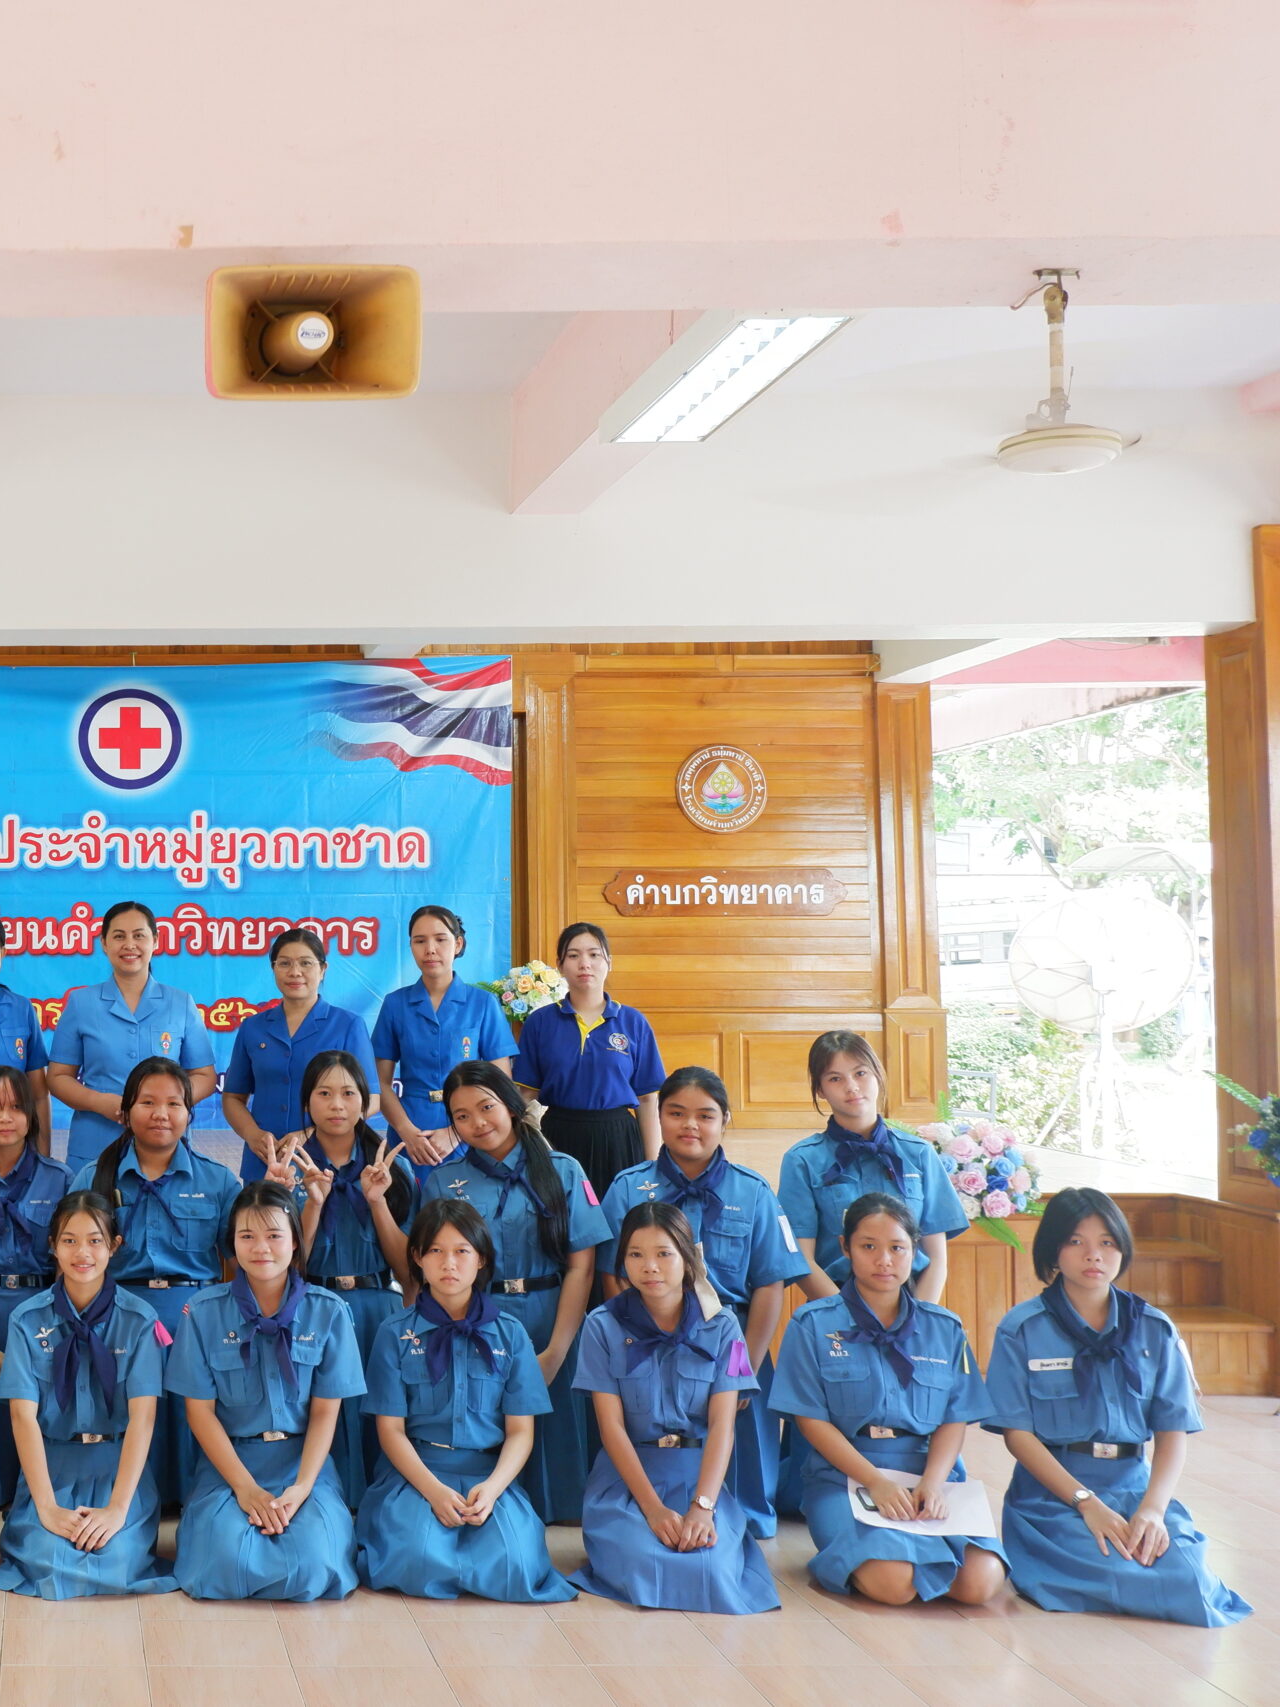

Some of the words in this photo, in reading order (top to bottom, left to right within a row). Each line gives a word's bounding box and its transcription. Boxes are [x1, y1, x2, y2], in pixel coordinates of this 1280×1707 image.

[625, 874, 825, 905] คำบกวิทยาคาร
